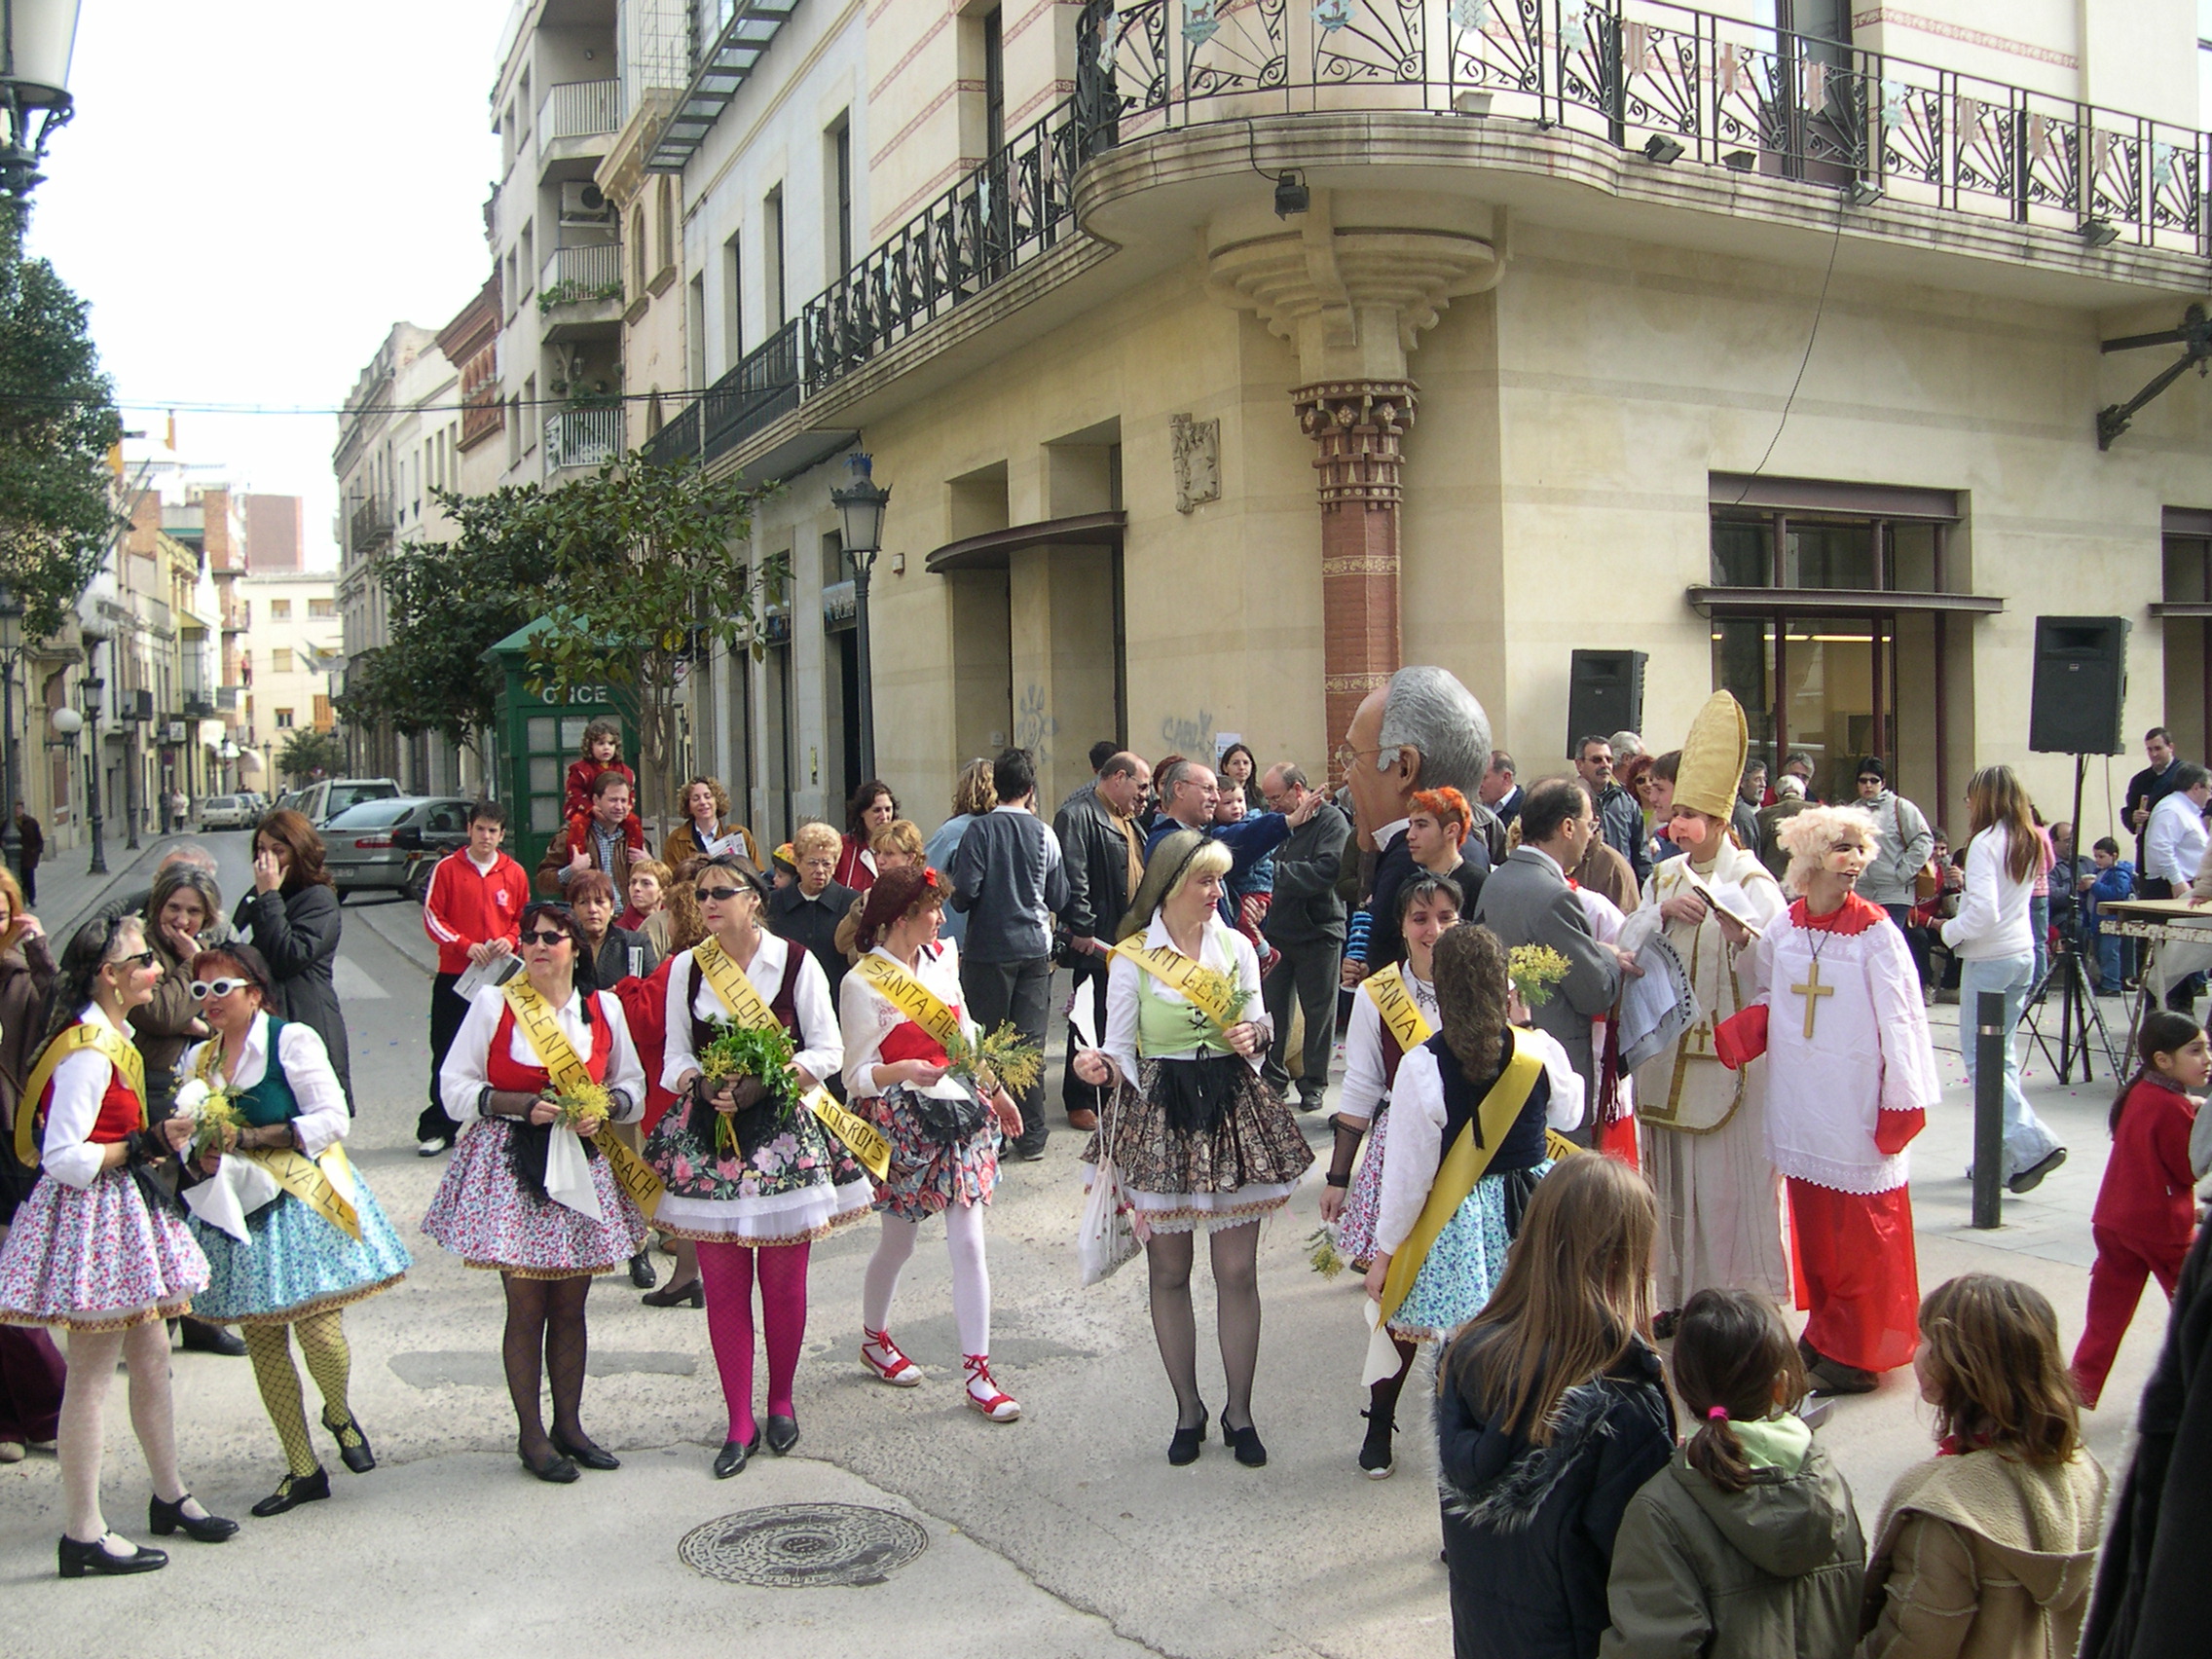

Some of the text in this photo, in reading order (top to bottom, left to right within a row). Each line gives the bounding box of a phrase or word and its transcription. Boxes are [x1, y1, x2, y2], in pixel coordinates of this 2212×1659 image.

[866, 960, 928, 1015] SANTA
[1370, 969, 1418, 1042] SANTA
[285, 1158, 356, 1227] VALLE
[594, 1130, 658, 1201] STRACH
